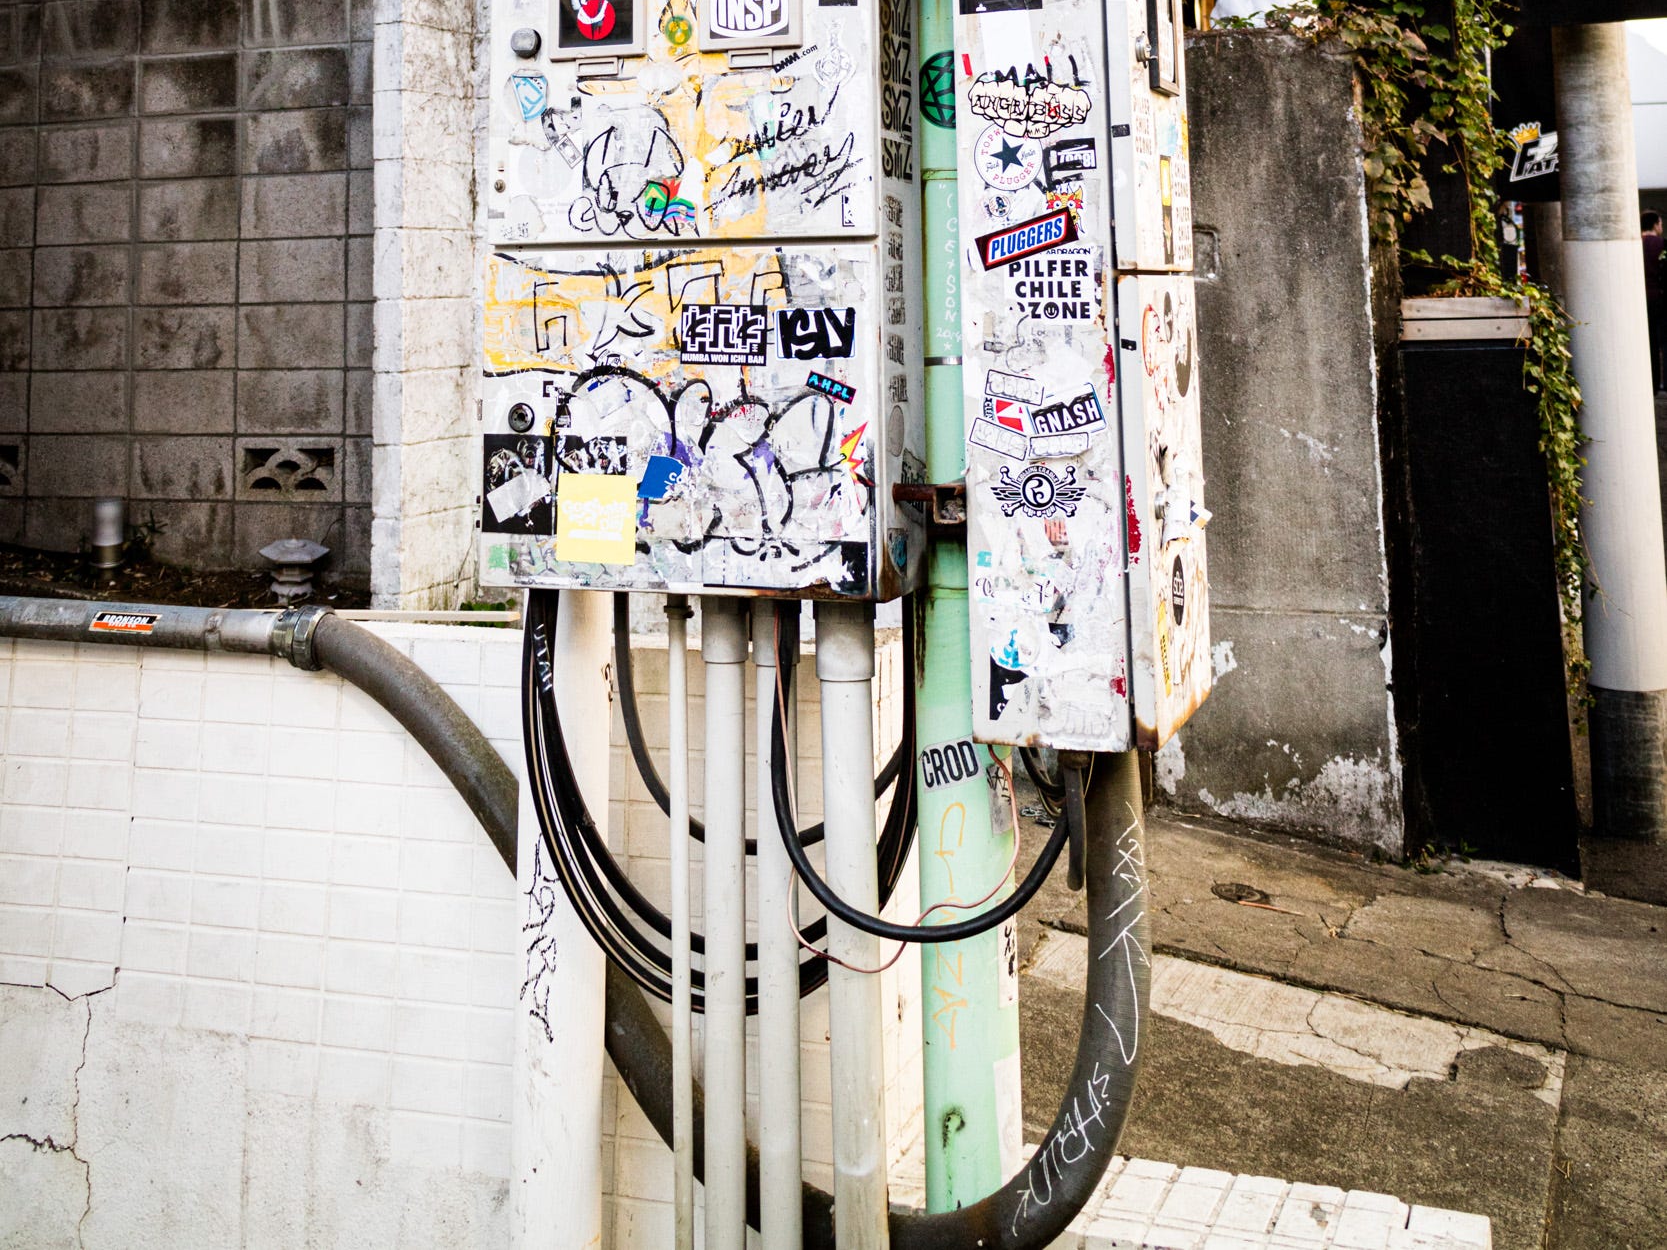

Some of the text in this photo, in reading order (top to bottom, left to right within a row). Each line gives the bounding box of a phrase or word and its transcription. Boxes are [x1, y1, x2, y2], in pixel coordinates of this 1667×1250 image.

[773, 44, 819, 74] DMM.com
[992, 161, 1036, 185] PLUGGER
[991, 217, 1063, 261] PLUGGERS
[1008, 259, 1089, 278] PILFER
[1015, 280, 1082, 298] CHILE
[682, 353, 765, 365] NUMBA WON ICHI BAN
[1035, 399, 1100, 435] GNASH
[921, 740, 980, 788] CROD
